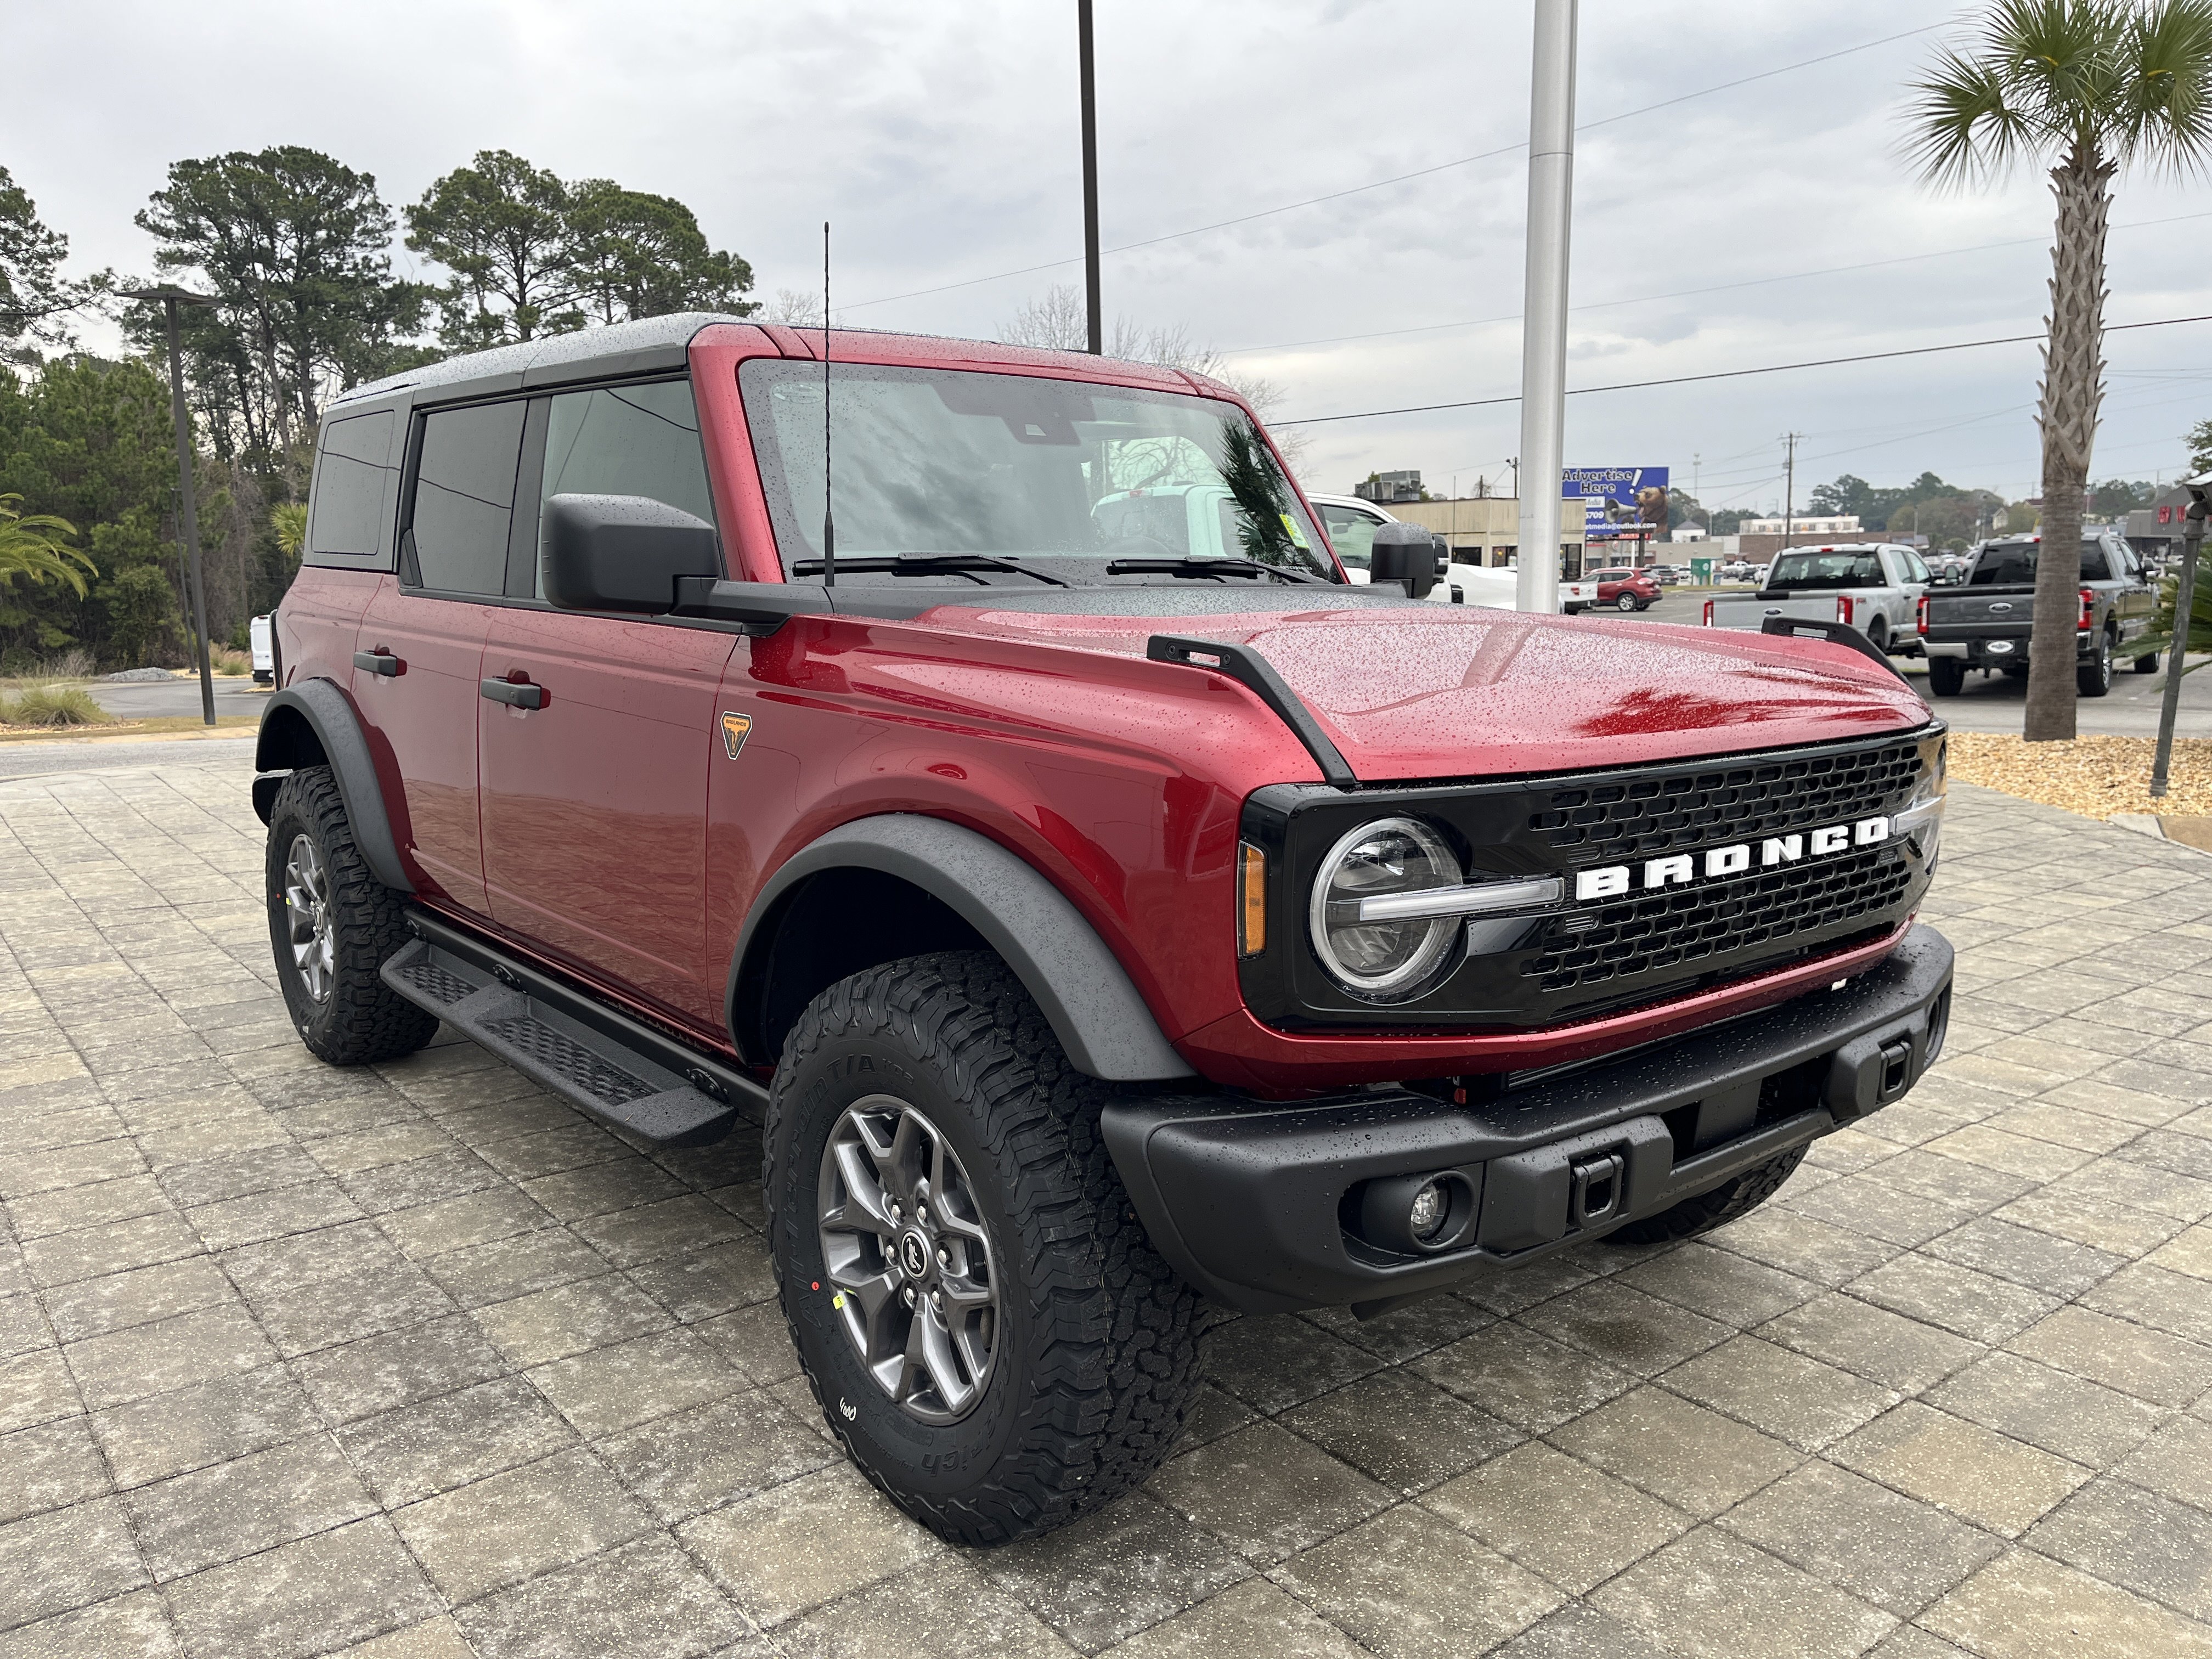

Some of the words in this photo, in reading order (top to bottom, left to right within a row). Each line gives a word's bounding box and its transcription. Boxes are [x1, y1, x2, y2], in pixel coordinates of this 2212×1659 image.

[1562, 468, 1633, 482] Advertise
[1580, 481, 1616, 493] Here
[1576, 816, 1889, 900] BRONCO
[825, 1053, 878, 1084] T/A
